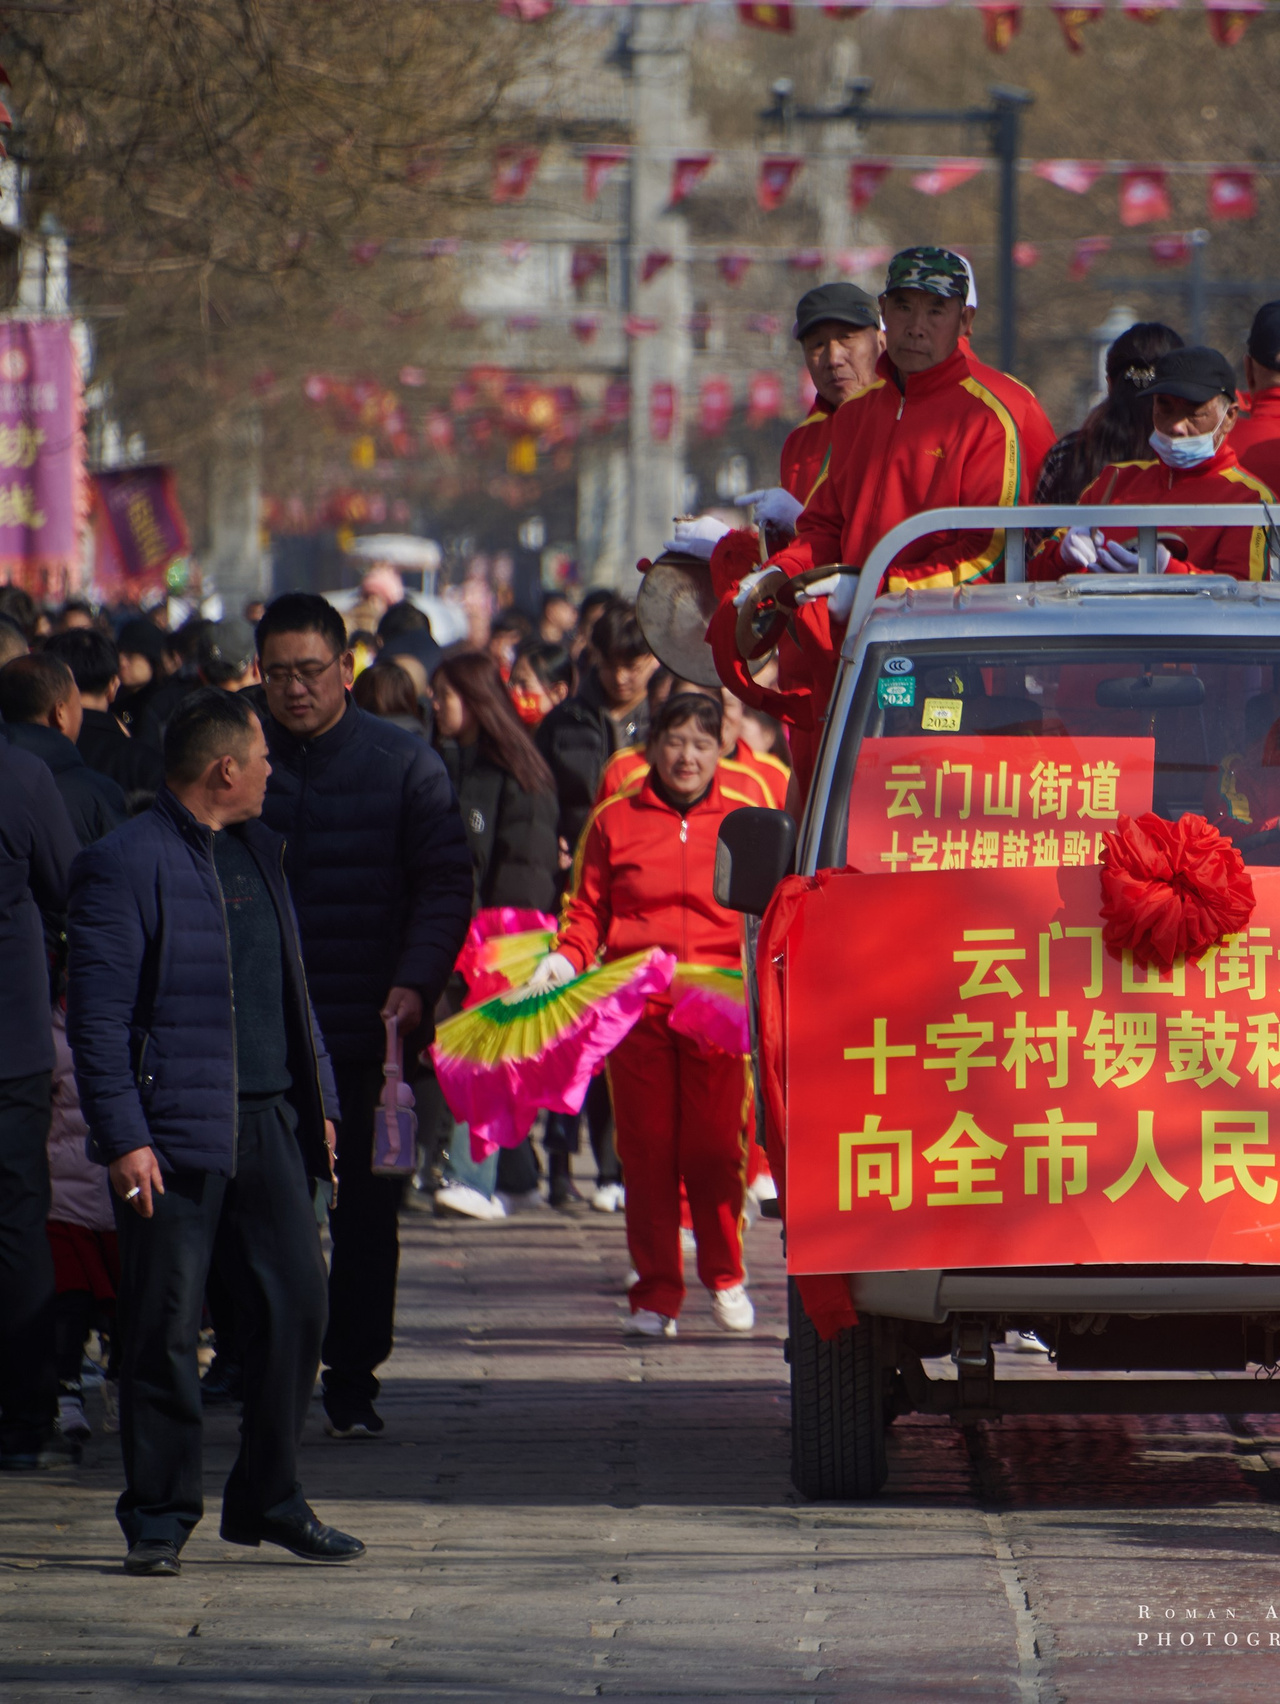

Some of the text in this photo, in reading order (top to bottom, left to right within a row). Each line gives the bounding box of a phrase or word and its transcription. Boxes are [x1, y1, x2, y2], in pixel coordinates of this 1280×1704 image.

[926, 717, 956, 728] 2023
[885, 760, 1121, 820] 云门山街道
[881, 829, 1116, 873] 十字村锣鼓秧歌
